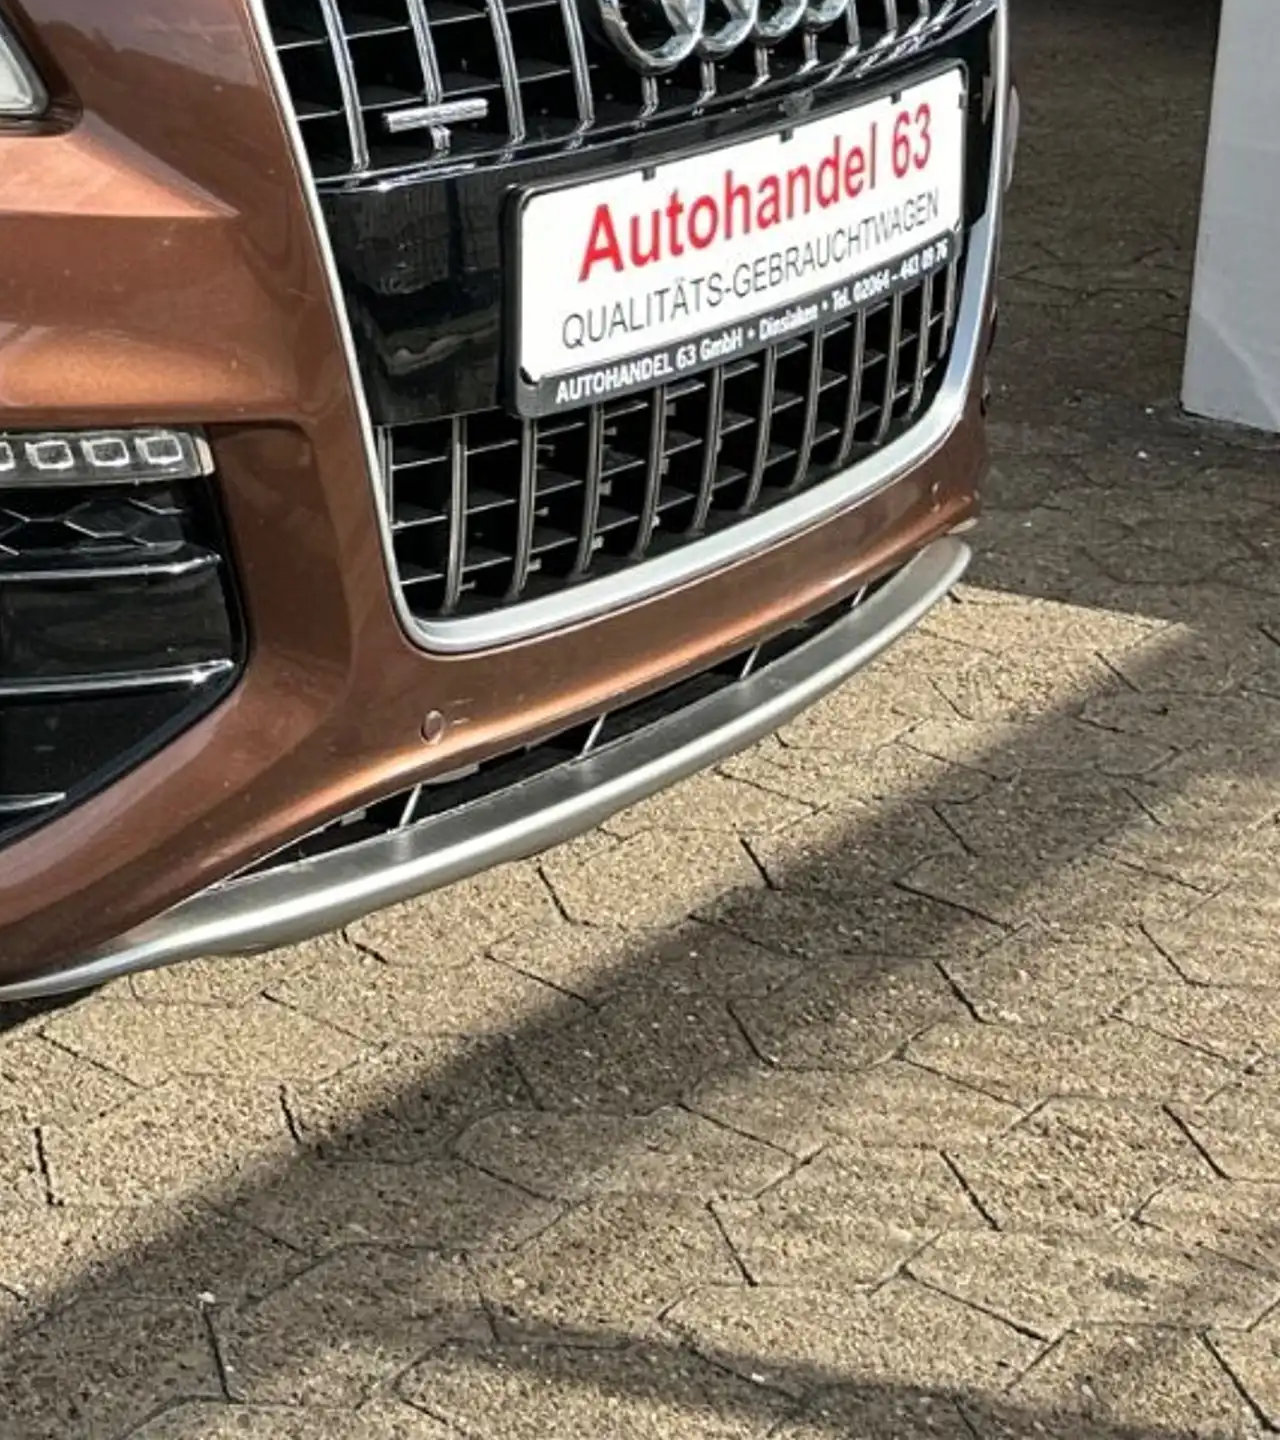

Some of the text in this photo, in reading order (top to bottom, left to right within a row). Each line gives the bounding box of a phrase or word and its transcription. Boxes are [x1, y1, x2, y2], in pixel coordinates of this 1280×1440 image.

[562, 188, 940, 349] QUALITÄTS-GEBRAUCHTWAGEN
[578, 103, 931, 282] Autohandel 63
[555, 353, 674, 404] AUTOHANDEL
[676, 344, 697, 371] 63
[700, 327, 744, 360] GmbH
